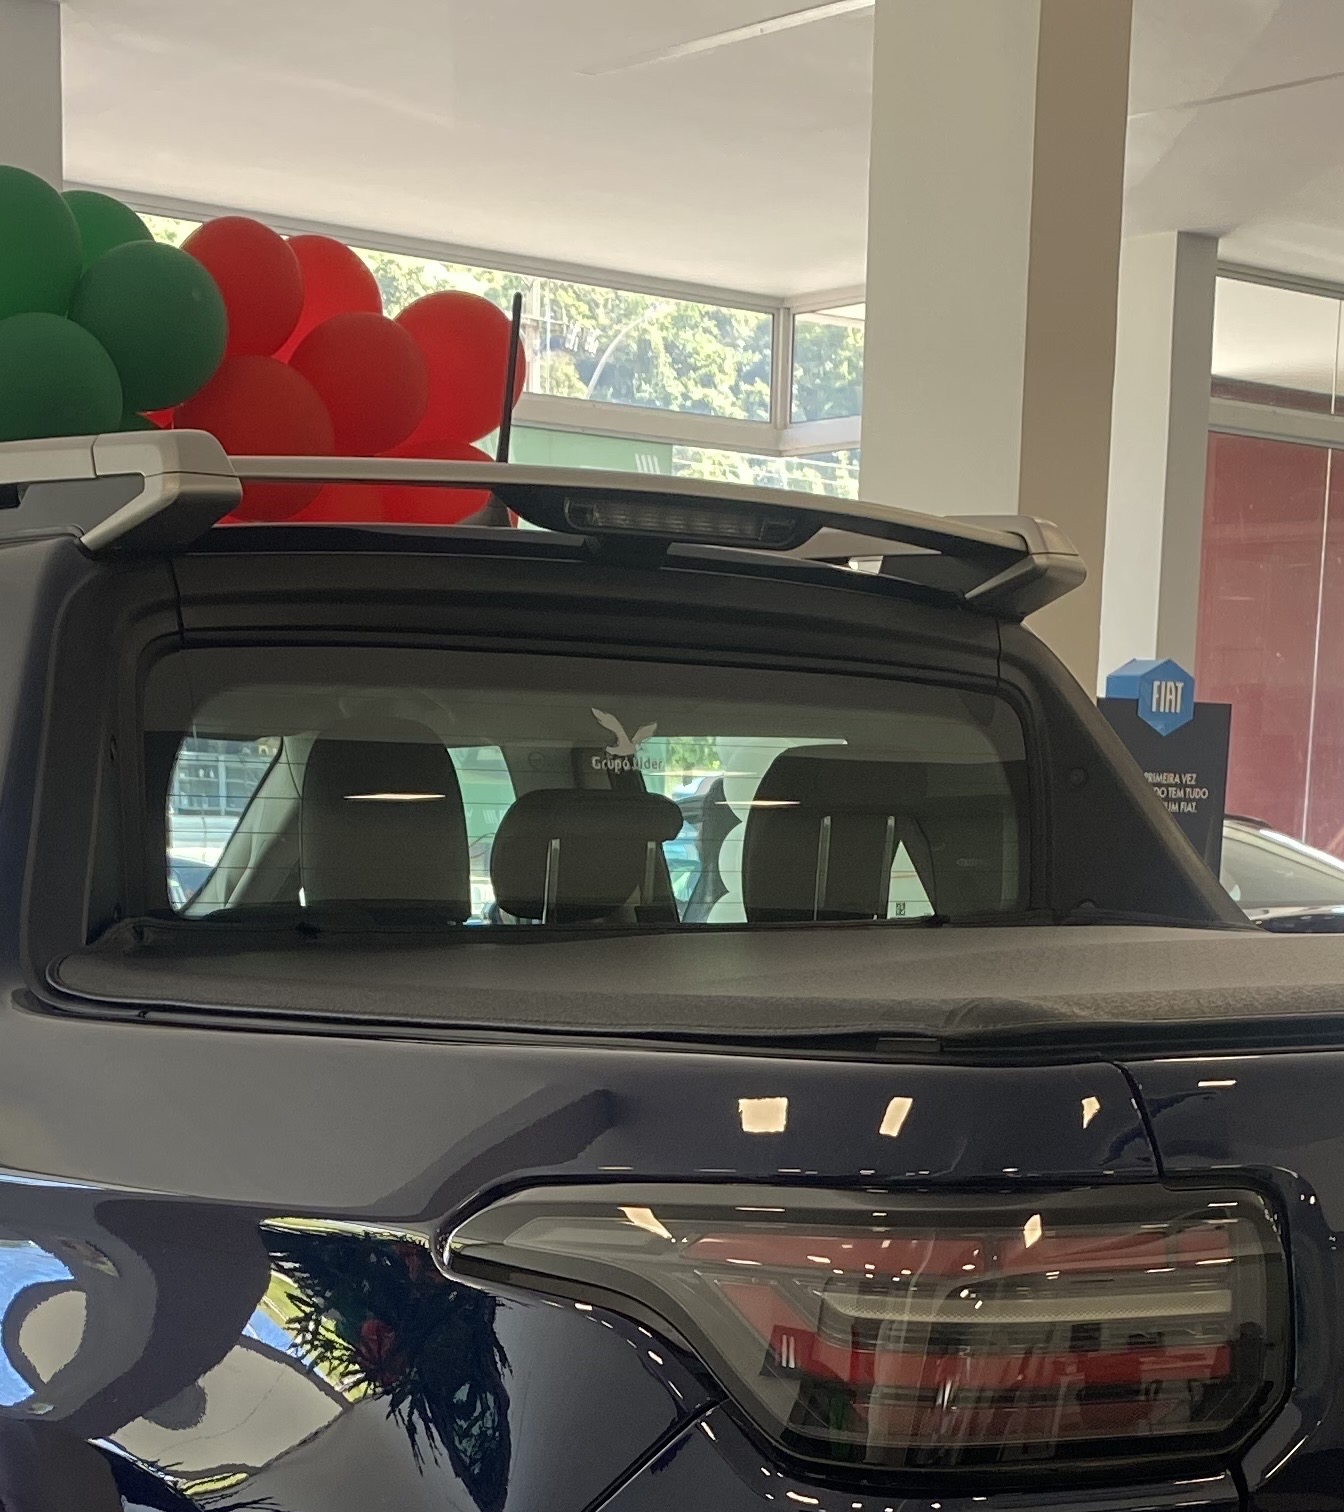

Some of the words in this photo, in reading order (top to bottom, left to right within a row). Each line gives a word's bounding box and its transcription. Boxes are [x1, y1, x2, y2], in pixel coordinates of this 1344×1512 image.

[1151, 680, 1184, 713] FIAT
[591, 755, 631, 775] Grupo
[1182, 773, 1196, 785] VEZ
[1168, 787, 1185, 798] TEM
[1186, 787, 1209, 799] TUDO
